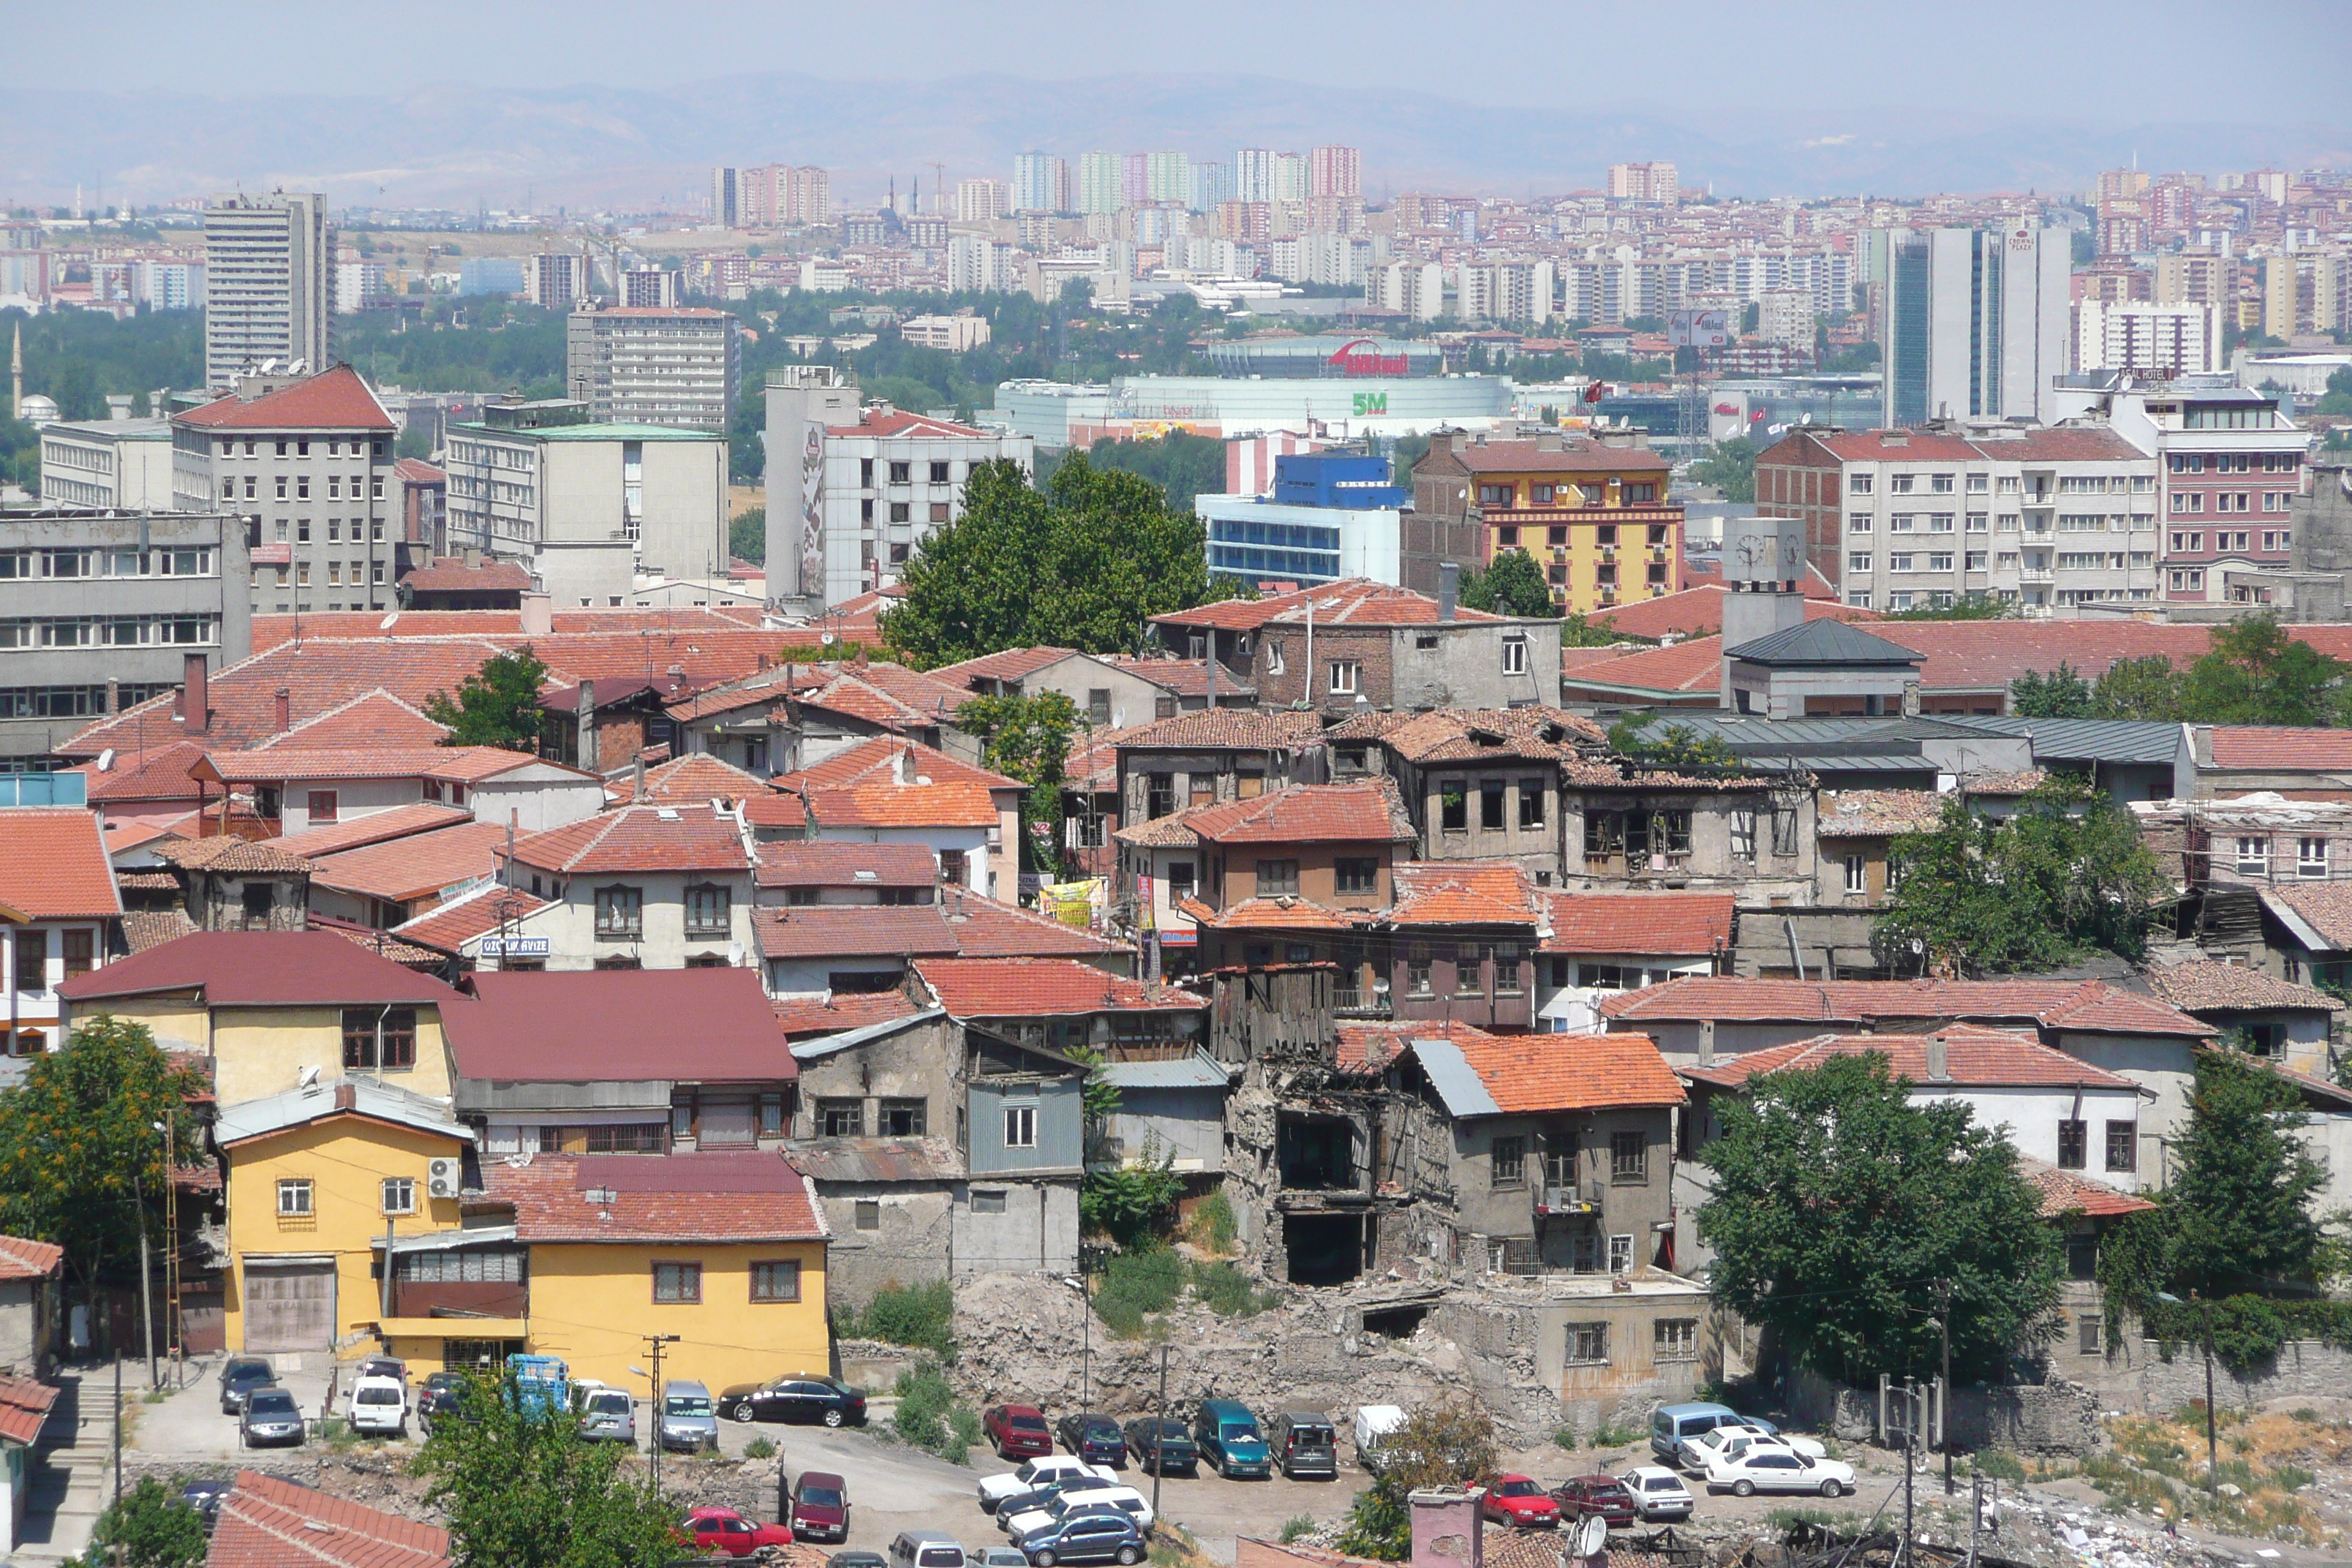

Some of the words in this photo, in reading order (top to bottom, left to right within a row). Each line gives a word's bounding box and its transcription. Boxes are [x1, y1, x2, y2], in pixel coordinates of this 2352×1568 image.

[2143, 369, 2166, 380] HOTEL
[1352, 392, 1387, 417] 5M
[484, 940, 519, 952] ÖZÇLİK
[521, 941, 547, 951] AVİZE
